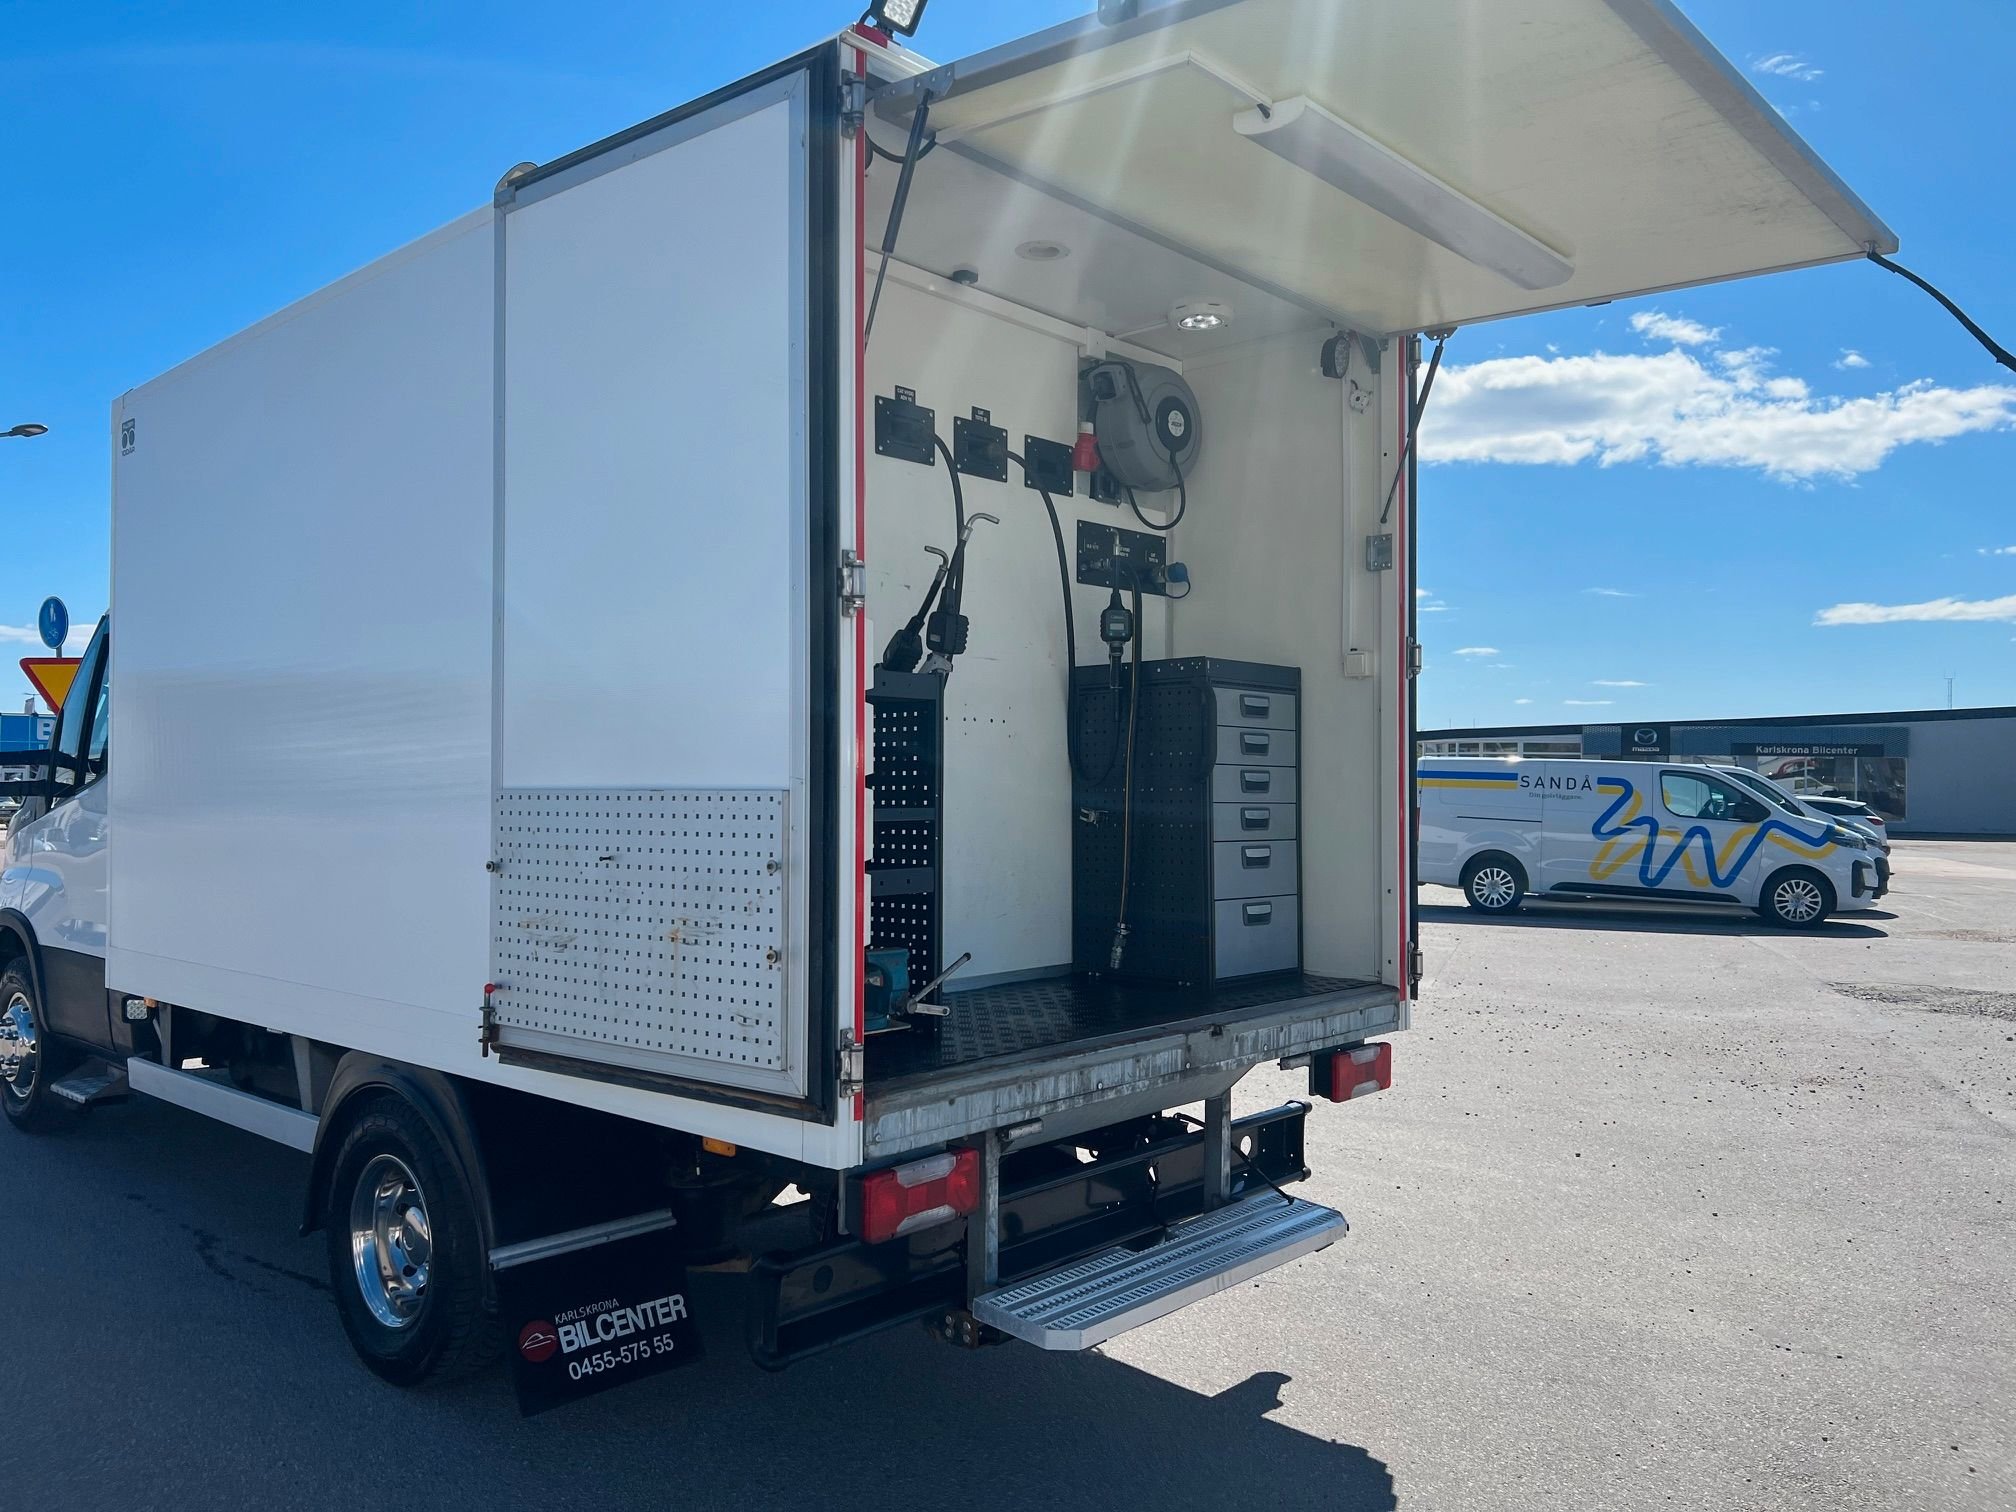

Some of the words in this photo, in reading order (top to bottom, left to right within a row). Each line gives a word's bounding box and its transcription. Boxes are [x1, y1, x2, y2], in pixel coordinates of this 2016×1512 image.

[1755, 745, 1809, 754] Karlskrona
[1812, 745, 1858, 755] Bilcenter
[1520, 774, 1592, 791] SANDÅ
[554, 1298, 620, 1325] KARLSKRONA
[557, 1293, 688, 1354] BILCENTER
[568, 1340, 651, 1380] 0455-575
[653, 1333, 674, 1355] 55
